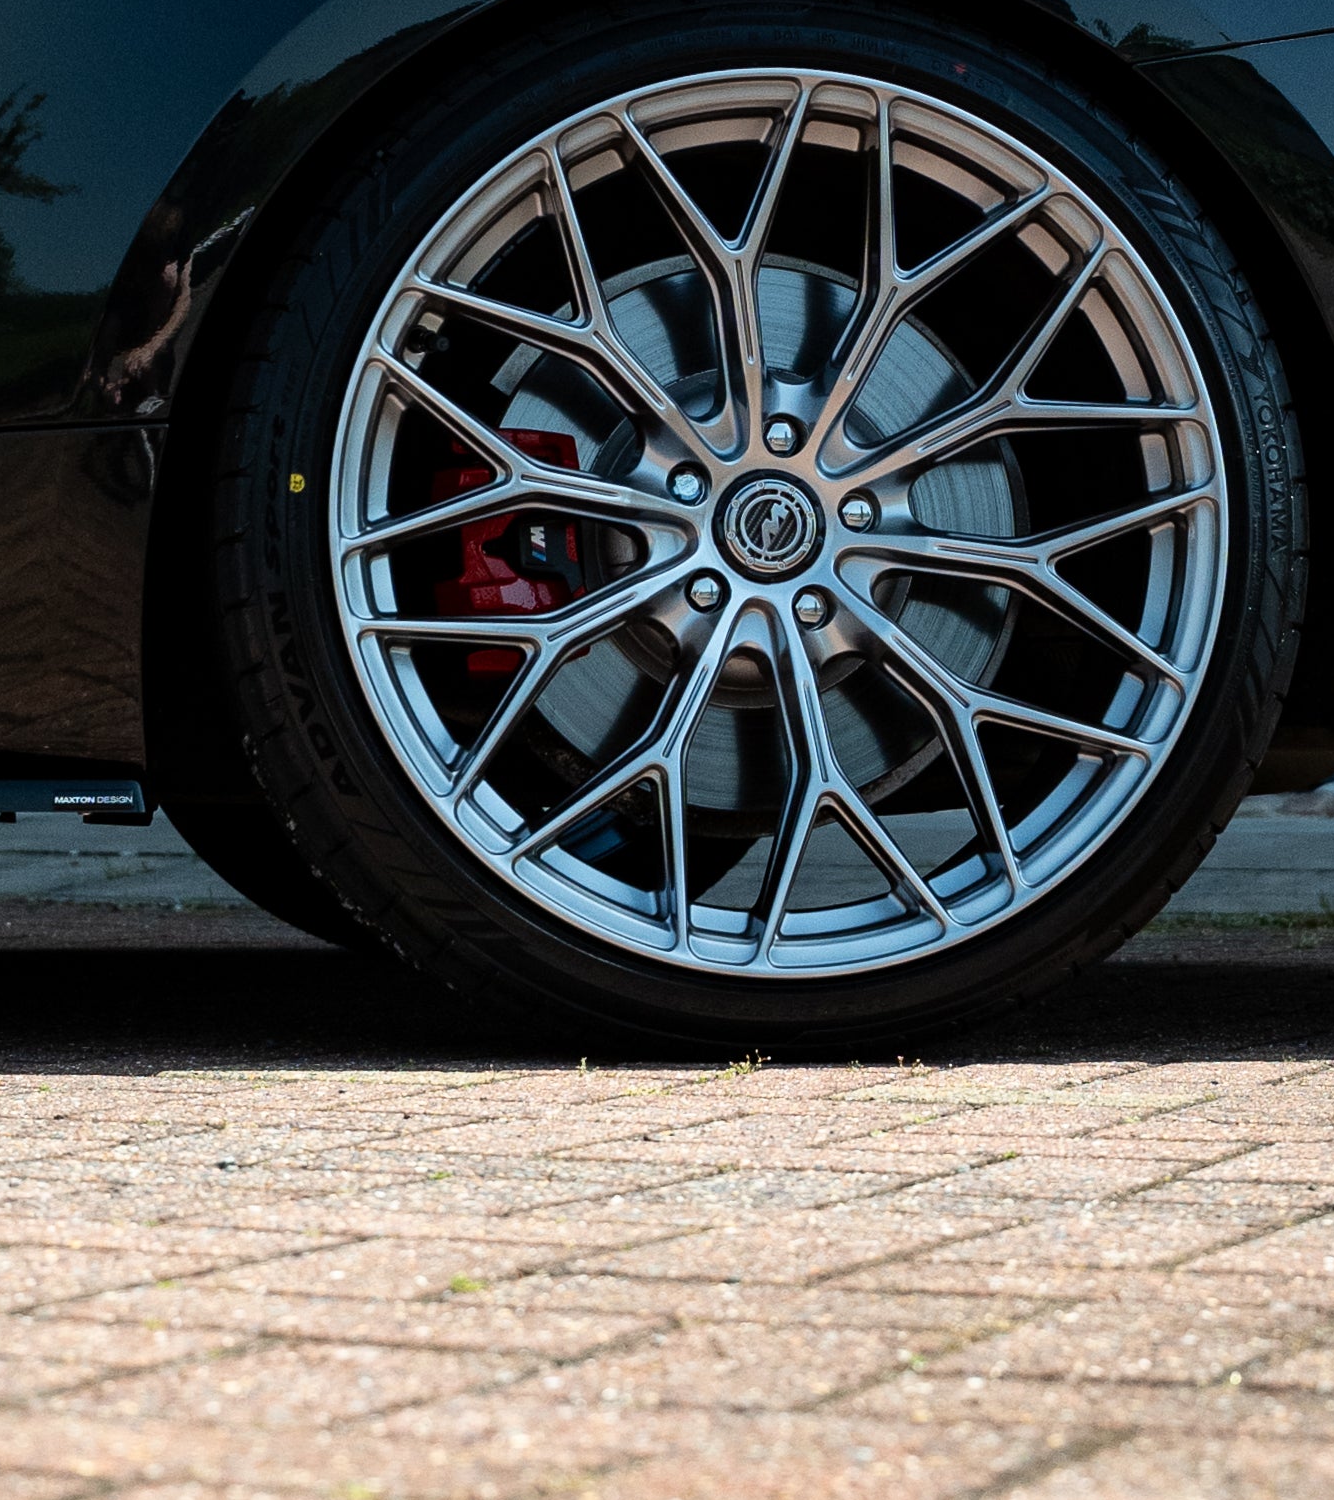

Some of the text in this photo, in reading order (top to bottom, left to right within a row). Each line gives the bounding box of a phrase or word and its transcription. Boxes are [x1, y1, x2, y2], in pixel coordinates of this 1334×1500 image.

[1253, 386, 1289, 554] YOKOHAMA
[269, 592, 363, 798] ADVAN
[53, 795, 134, 804] MAXTON DESIGN
